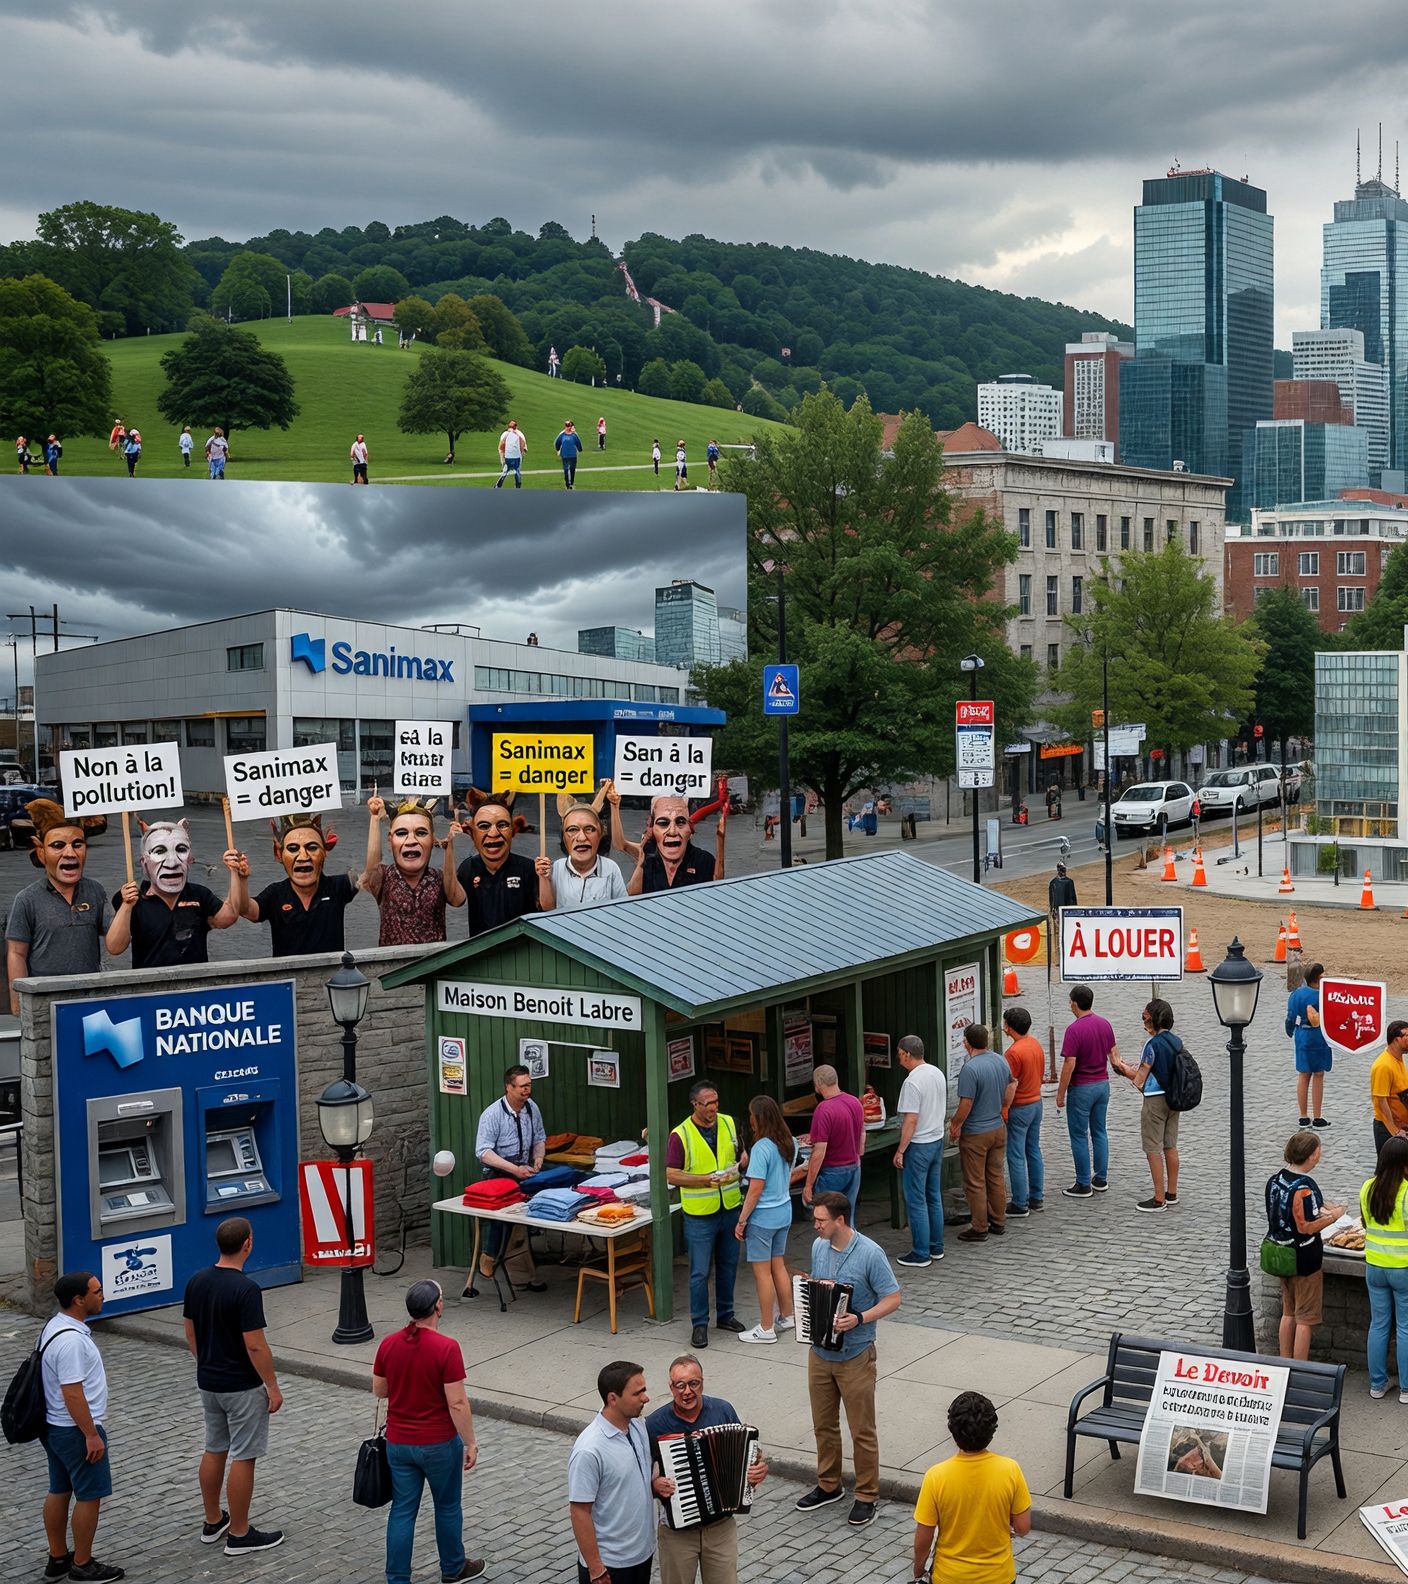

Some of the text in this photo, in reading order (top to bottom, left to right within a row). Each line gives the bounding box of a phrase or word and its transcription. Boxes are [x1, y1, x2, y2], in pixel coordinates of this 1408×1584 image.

[332, 641, 454, 683] Sanimax
[73, 750, 163, 779] Non à la
[499, 739, 586, 760] Sanimax
[623, 741, 663, 762] San
[688, 743, 704, 764] la
[231, 756, 328, 782] Sanimax
[519, 764, 588, 786] danger
[72, 776, 176, 812] pollution!
[258, 783, 333, 808] danger
[1069, 922, 1175, 958] À LOUER
[155, 1000, 256, 1031] BANQUE
[444, 987, 634, 1023] Maison Benoit Labre
[155, 1023, 282, 1057] NATIONALE
[1174, 1358, 1270, 1390] Le Devoir
